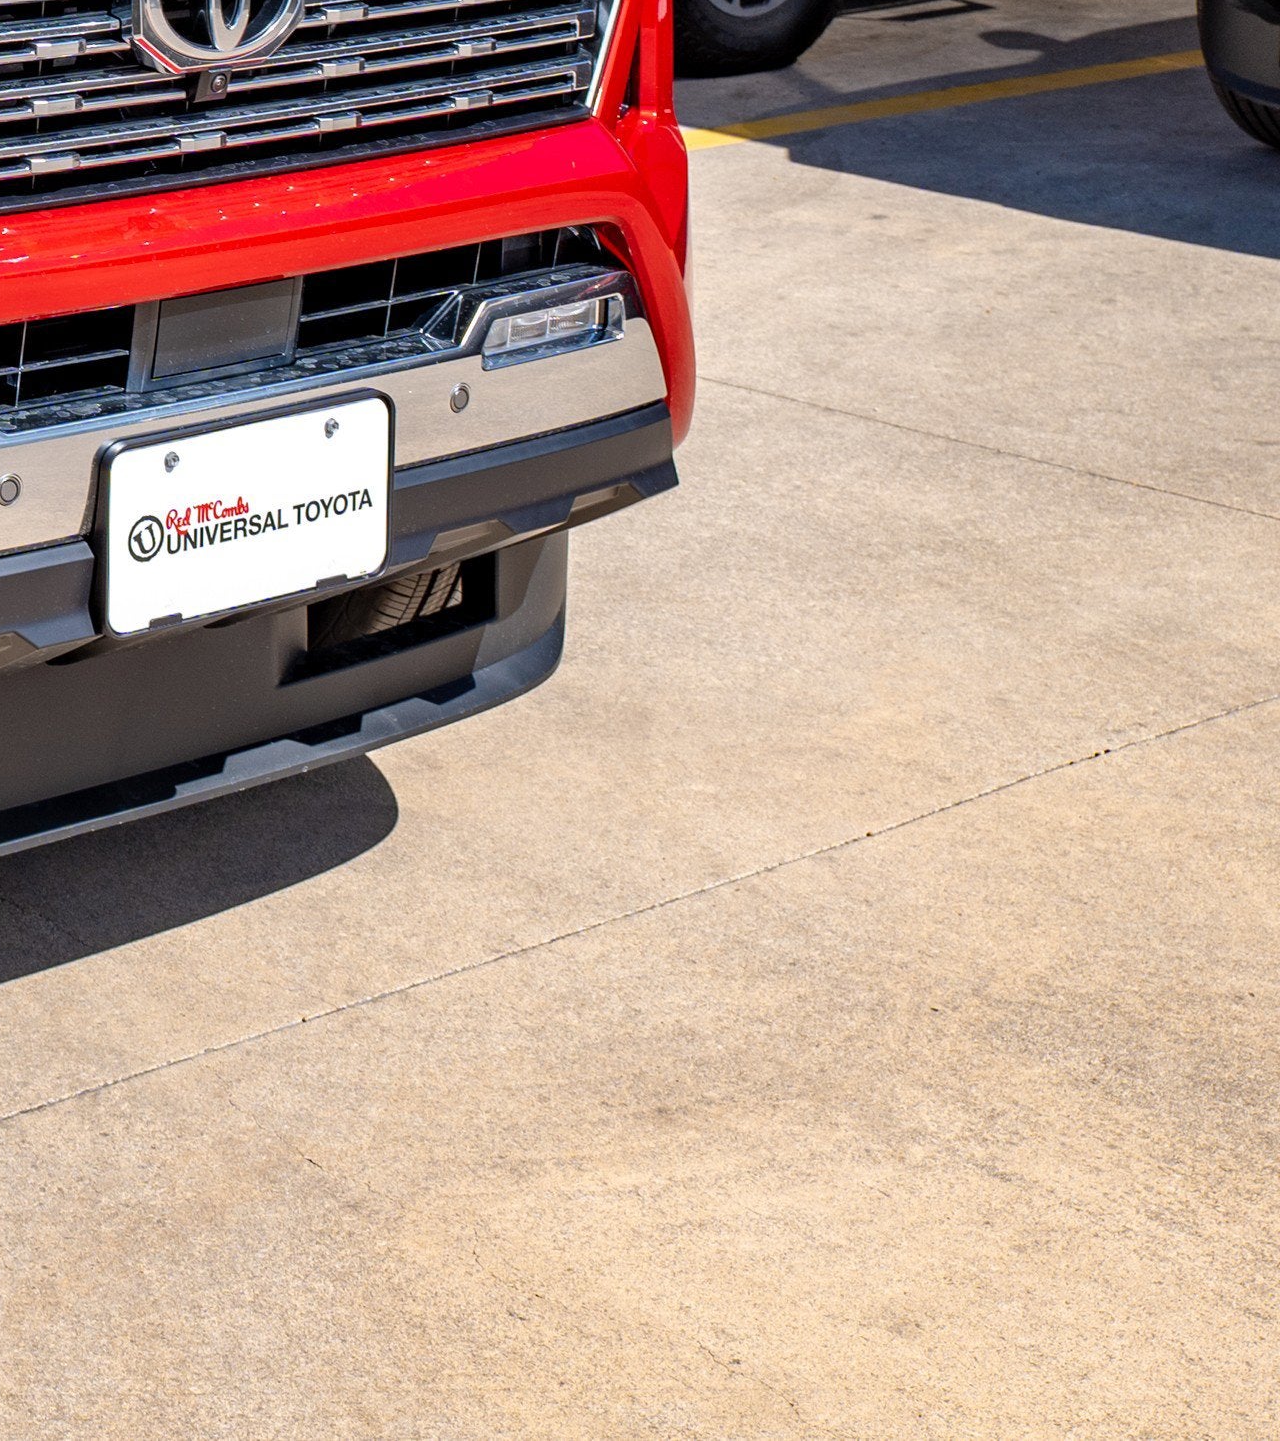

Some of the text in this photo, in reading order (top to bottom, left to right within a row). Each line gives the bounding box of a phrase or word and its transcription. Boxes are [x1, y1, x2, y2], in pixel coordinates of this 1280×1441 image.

[166, 488, 373, 555] UNIVERSAL TOYOTA
[166, 507, 191, 537] Red
